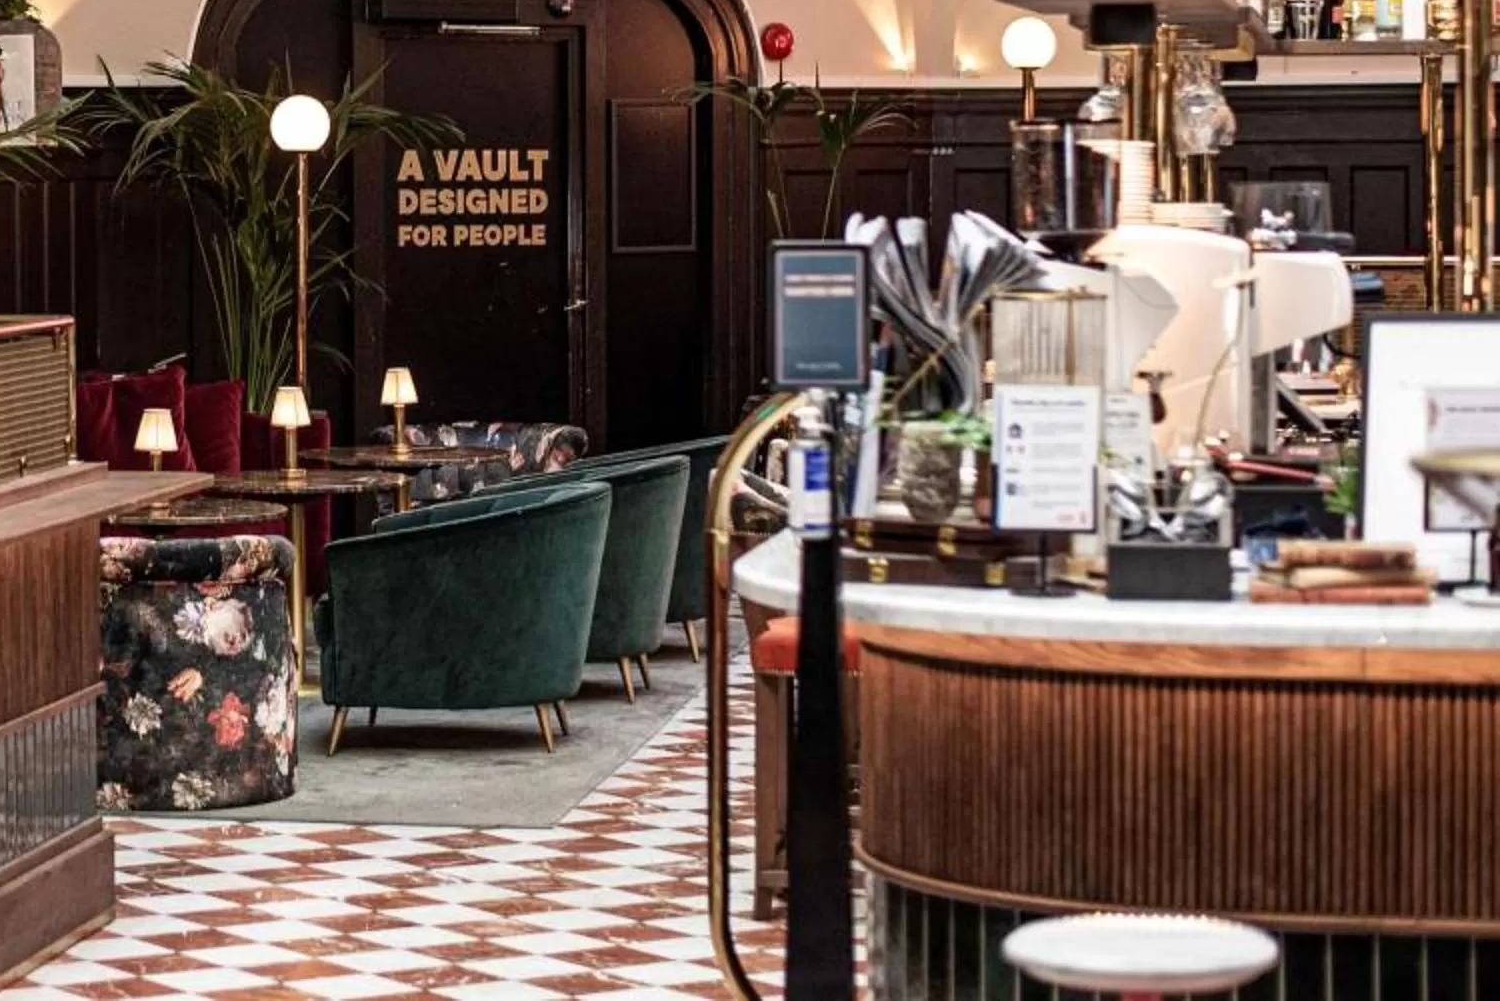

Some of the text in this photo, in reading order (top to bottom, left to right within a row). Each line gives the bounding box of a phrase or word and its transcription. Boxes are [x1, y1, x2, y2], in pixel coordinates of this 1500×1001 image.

[397, 149, 550, 182] A VAULT
[398, 188, 549, 215] DESIGNED
[397, 224, 547, 247] FOR PEOPLE
